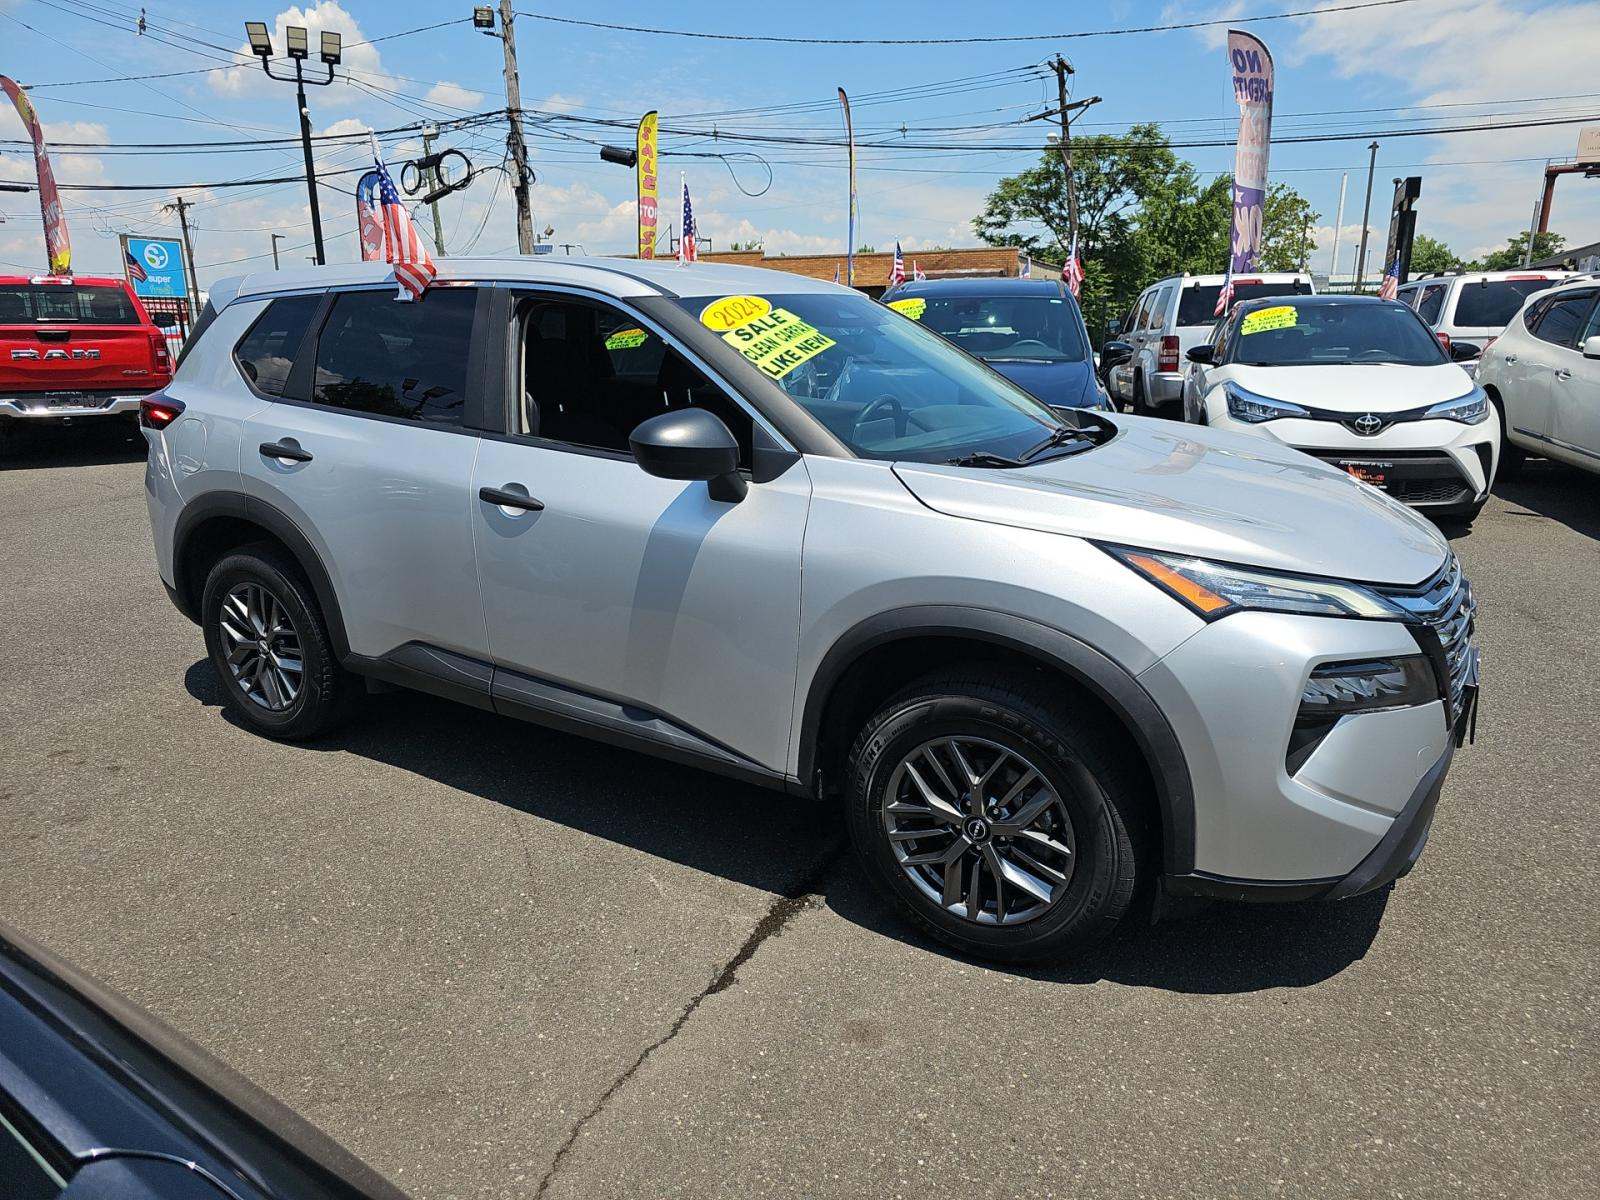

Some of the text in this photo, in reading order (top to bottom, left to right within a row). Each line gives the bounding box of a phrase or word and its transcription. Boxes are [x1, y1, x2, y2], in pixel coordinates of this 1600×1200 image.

[713, 298, 762, 327] 2024
[735, 312, 788, 341] SALE
[10, 348, 101, 361] RAM
[743, 321, 812, 361] CLEAN CARFAX
[762, 333, 829, 376] LIKE NEW
